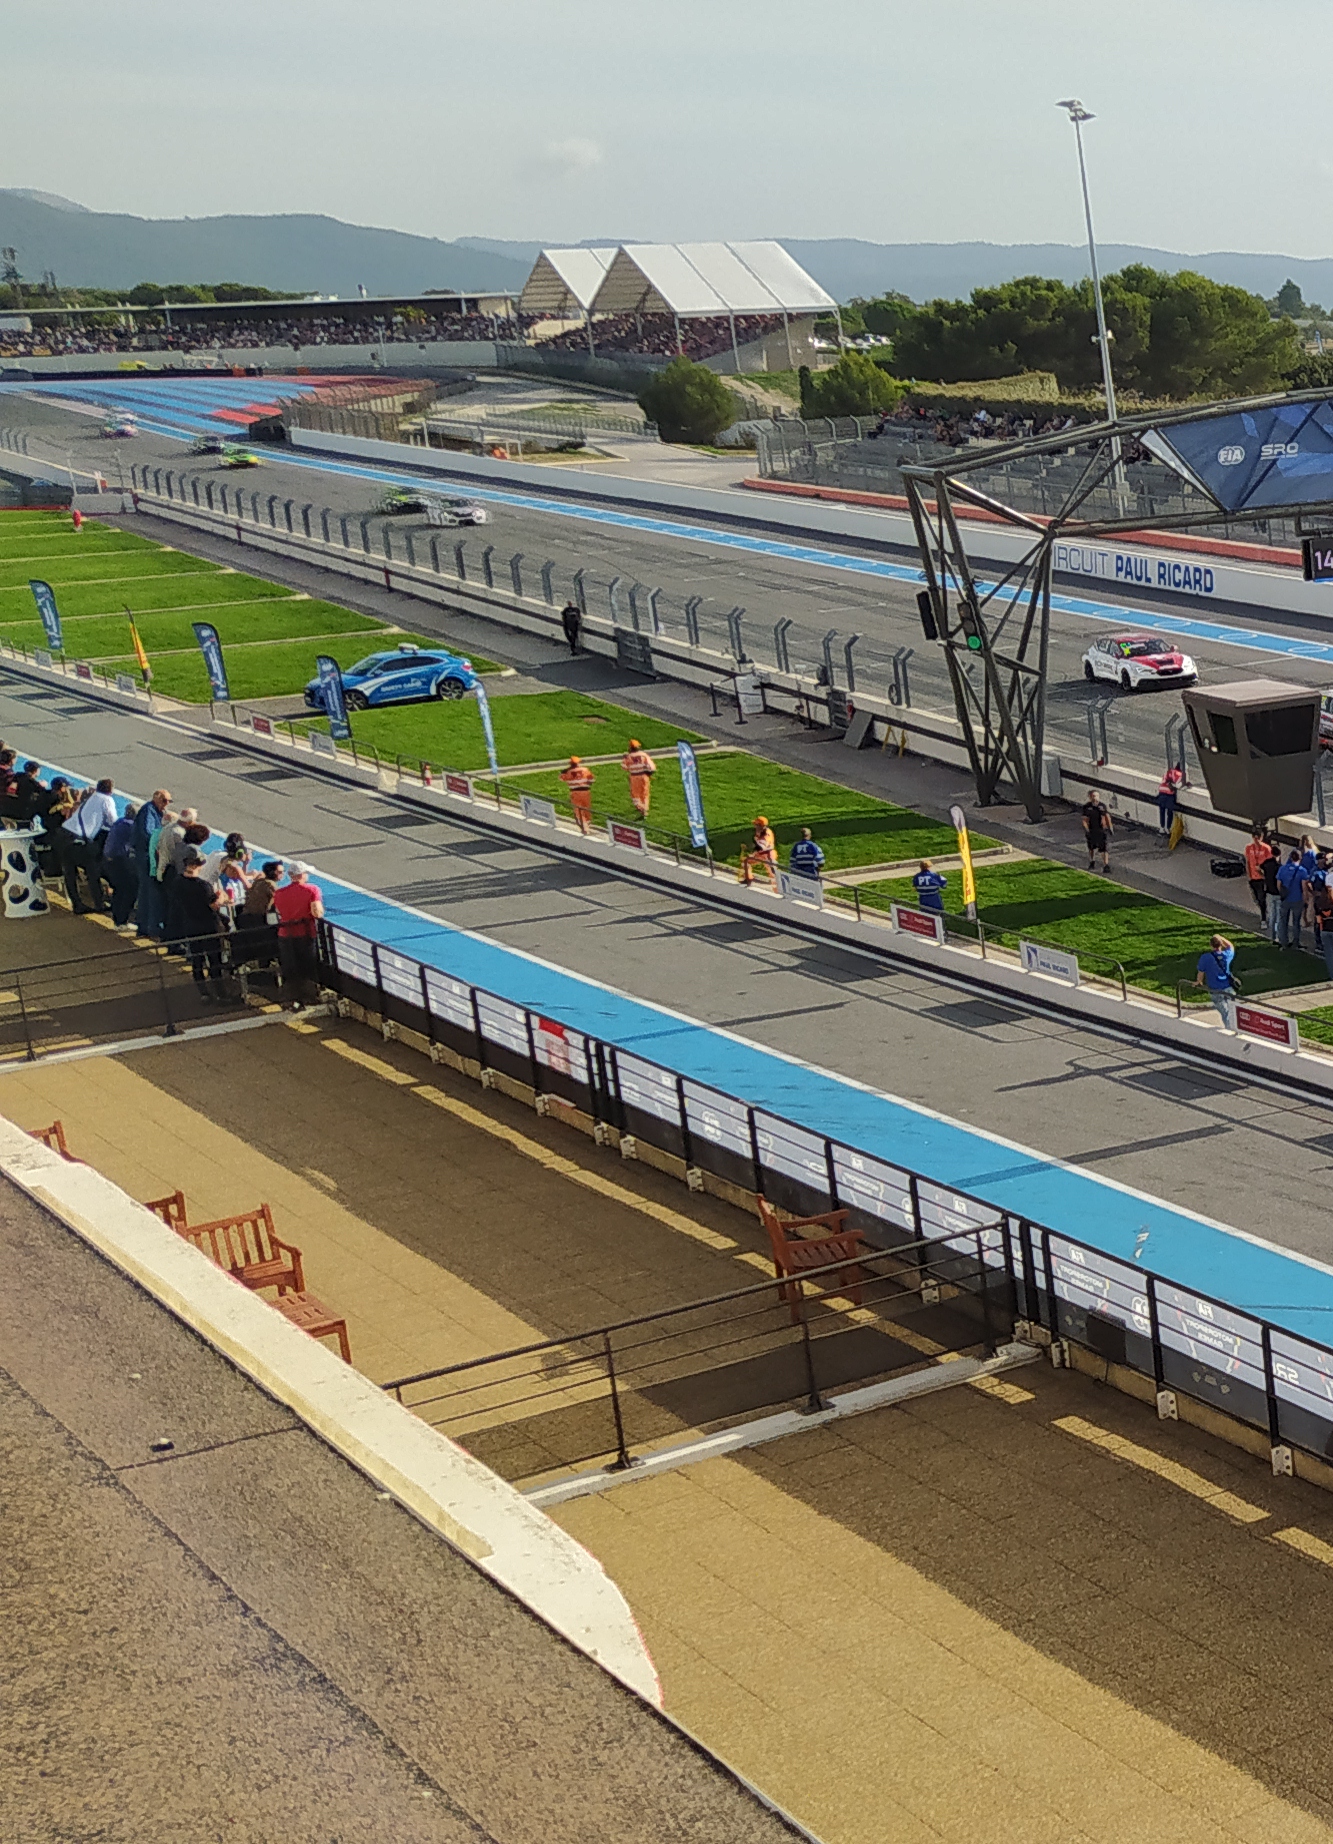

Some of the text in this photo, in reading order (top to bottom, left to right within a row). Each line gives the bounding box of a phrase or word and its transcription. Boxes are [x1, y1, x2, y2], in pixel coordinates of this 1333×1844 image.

[1219, 448, 1244, 463] FIA
[1261, 443, 1299, 456] SRO
[1052, 545, 1214, 593] IRCUIT PAUL RICARD
[918, 875, 931, 886] PT
